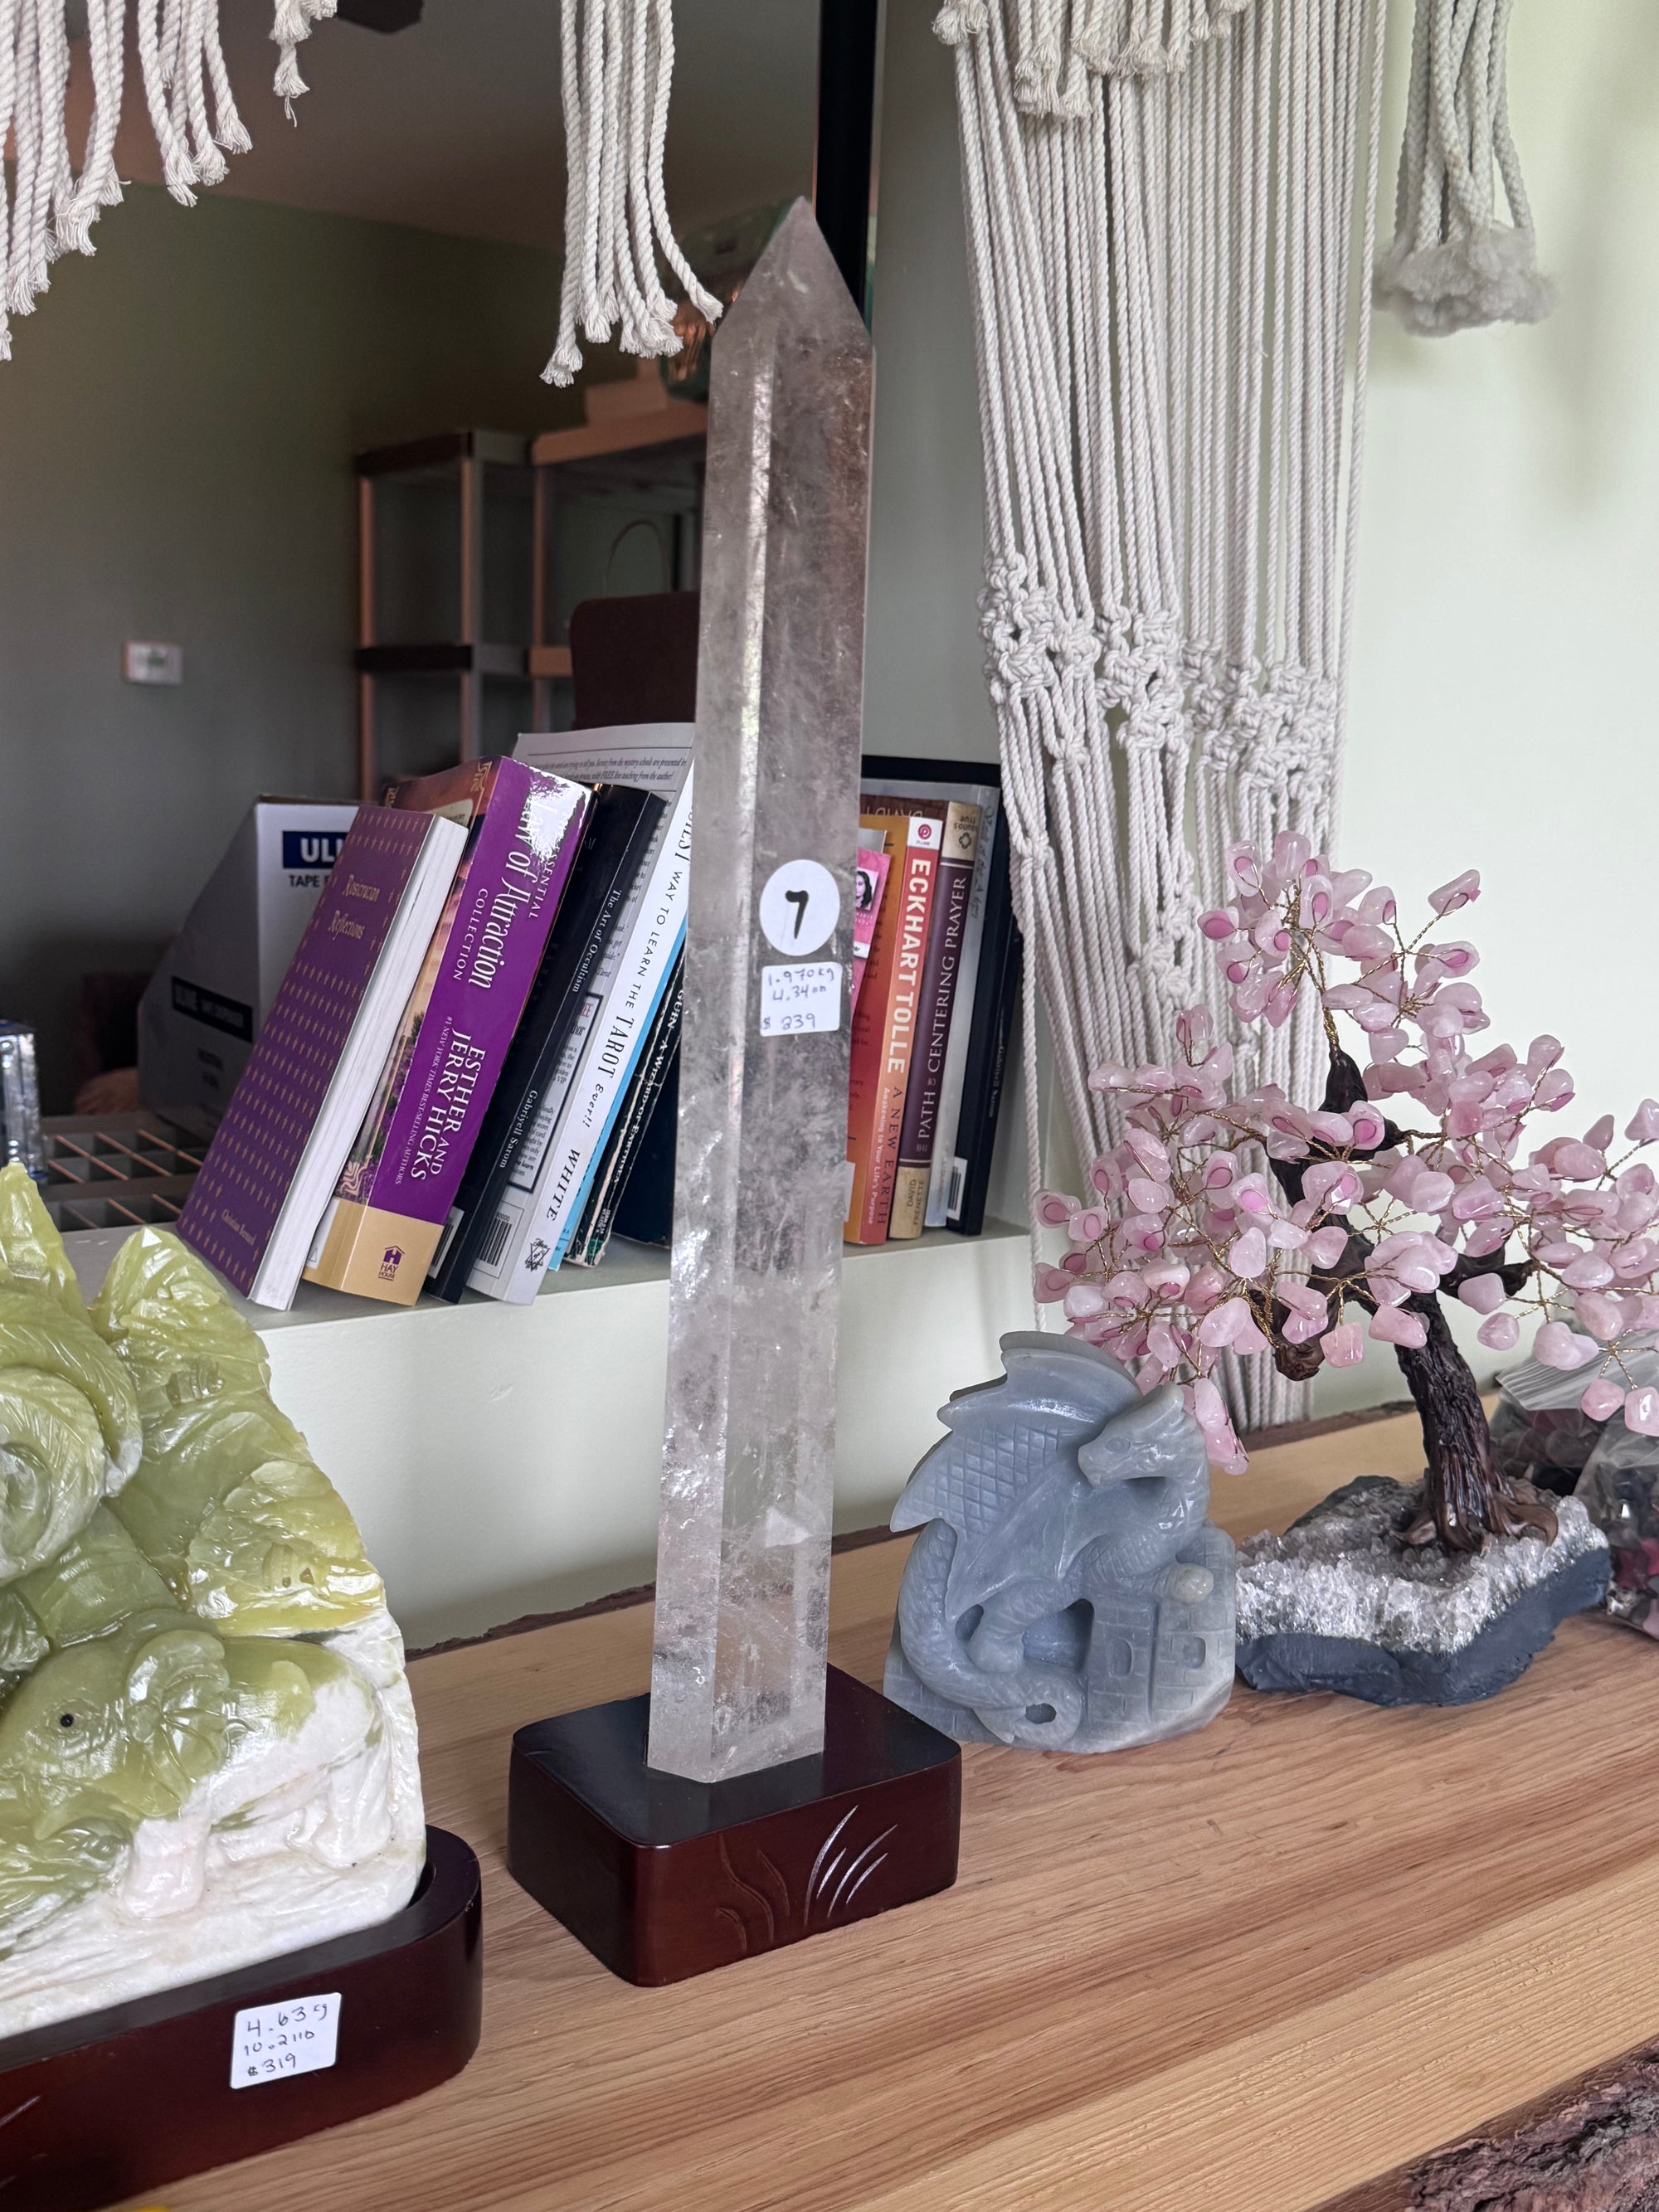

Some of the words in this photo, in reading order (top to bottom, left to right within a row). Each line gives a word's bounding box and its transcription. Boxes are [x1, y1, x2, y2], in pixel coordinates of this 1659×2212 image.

[289, 875, 320, 887] TAPE
[506, 850, 538, 883] of
[528, 844, 561, 918] ESSENTIAL
[608, 889, 623, 908] The
[667, 871, 683, 902] WAY
[328, 910, 365, 941] Reflections
[468, 877, 531, 989] Attraction
[599, 909, 612, 927] Art
[656, 907, 669, 926] TO
[785, 890, 809, 939] 7
[898, 858, 932, 986] ECKHART
[453, 888, 489, 981] COLLECTION
[594, 929, 603, 943] of
[572, 943, 598, 993] Occultism
[637, 931, 660, 977] LEARN
[625, 983, 642, 1009] THE
[918, 1091, 936, 1138] PATH
[927, 955, 955, 1073] CENTERING
[944, 877, 967, 948] PRAYER
[439, 1027, 450, 1045] NEW
[598, 1015, 635, 1079] TAROT
[659, 1039, 668, 1053] A
[888, 993, 915, 1074] TOLLE
[432, 1047, 443, 1067] YORK
[437, 1028, 472, 1102] JERRY
[424, 1067, 437, 1092] TIMES
[443, 1046, 486, 1133] ESTHER
[642, 1055, 664, 1104] WIZARD
[893, 1087, 903, 1098] A
[513, 1089, 538, 1136] Gabriyell
[582, 1083, 604, 1128] Ever!!
[877, 1088, 890, 1131] Awakening
[411, 1106, 448, 1181] HICKS
[877, 1134, 884, 1144] to
[887, 1108, 901, 1150] NEW
[395, 1147, 413, 1185] AUTHORS
[430, 1137, 450, 1175] AND
[499, 1137, 519, 1169] Sarom
[613, 1124, 640, 1184] EARTHSEA
[876, 1144, 884, 1160] Your
[547, 1149, 580, 1221] WHITE
[872, 1167, 881, 1190] Life's
[877, 1159, 894, 1224] EARTH
[906, 1179, 917, 1208] DAVID
[869, 1192, 878, 1225] Purpose
[914, 1180, 925, 1226] FRENETTE
[381, 1262, 399, 1273] HAY
